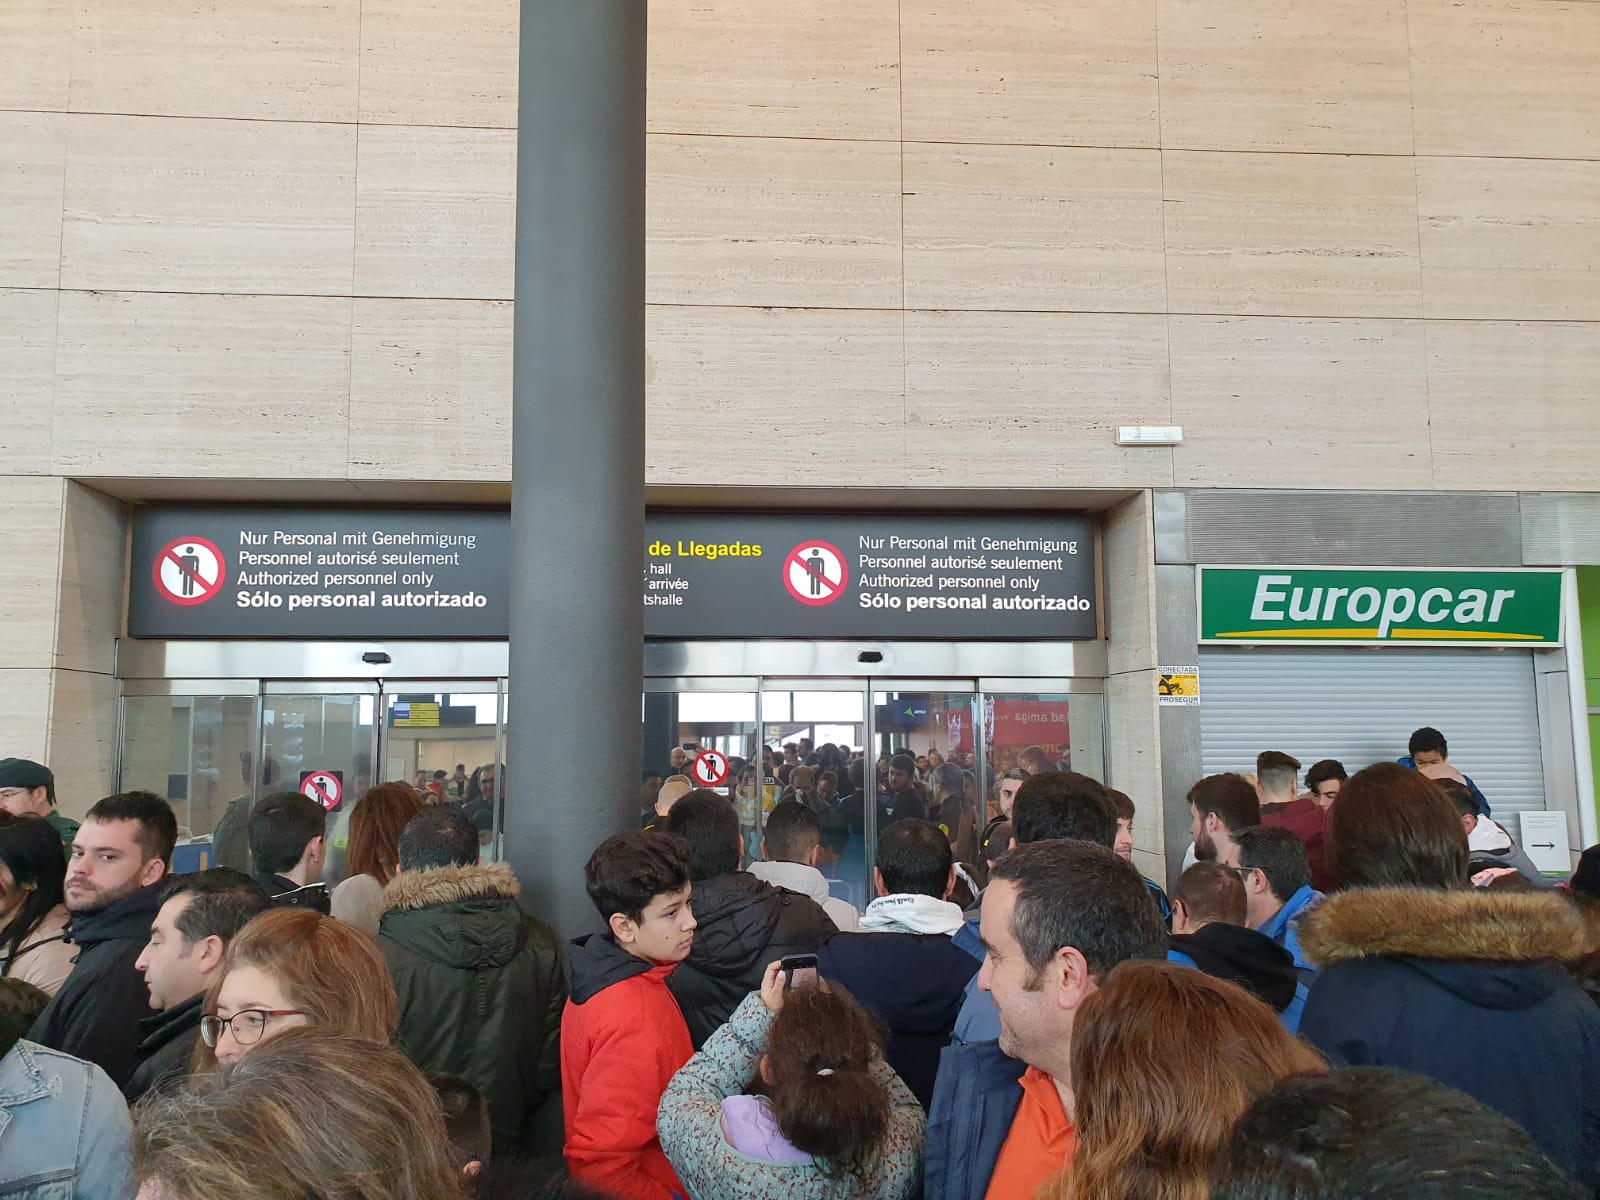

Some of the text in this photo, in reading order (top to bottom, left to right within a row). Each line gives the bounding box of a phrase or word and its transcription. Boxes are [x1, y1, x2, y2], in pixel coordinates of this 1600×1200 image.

[240, 531, 476, 549] Nur Personal mit Genehmigung
[860, 536, 1077, 554] Nur Personal mit Genehmigung
[239, 551, 459, 565] Personnel autorisé seulement
[649, 541, 761, 560] de Llegadas
[651, 563, 671, 574] hall
[860, 555, 1063, 570] Personnel autorisé seulement
[237, 571, 434, 588] Authorized personnel only
[859, 574, 1039, 591] Authorized personnel only
[237, 591, 487, 611] Sólo personal autorizado
[644, 594, 682, 605] tshalle
[860, 593, 1090, 612] Sólo personal autorizado
[1250, 576, 1514, 638] Europcar
